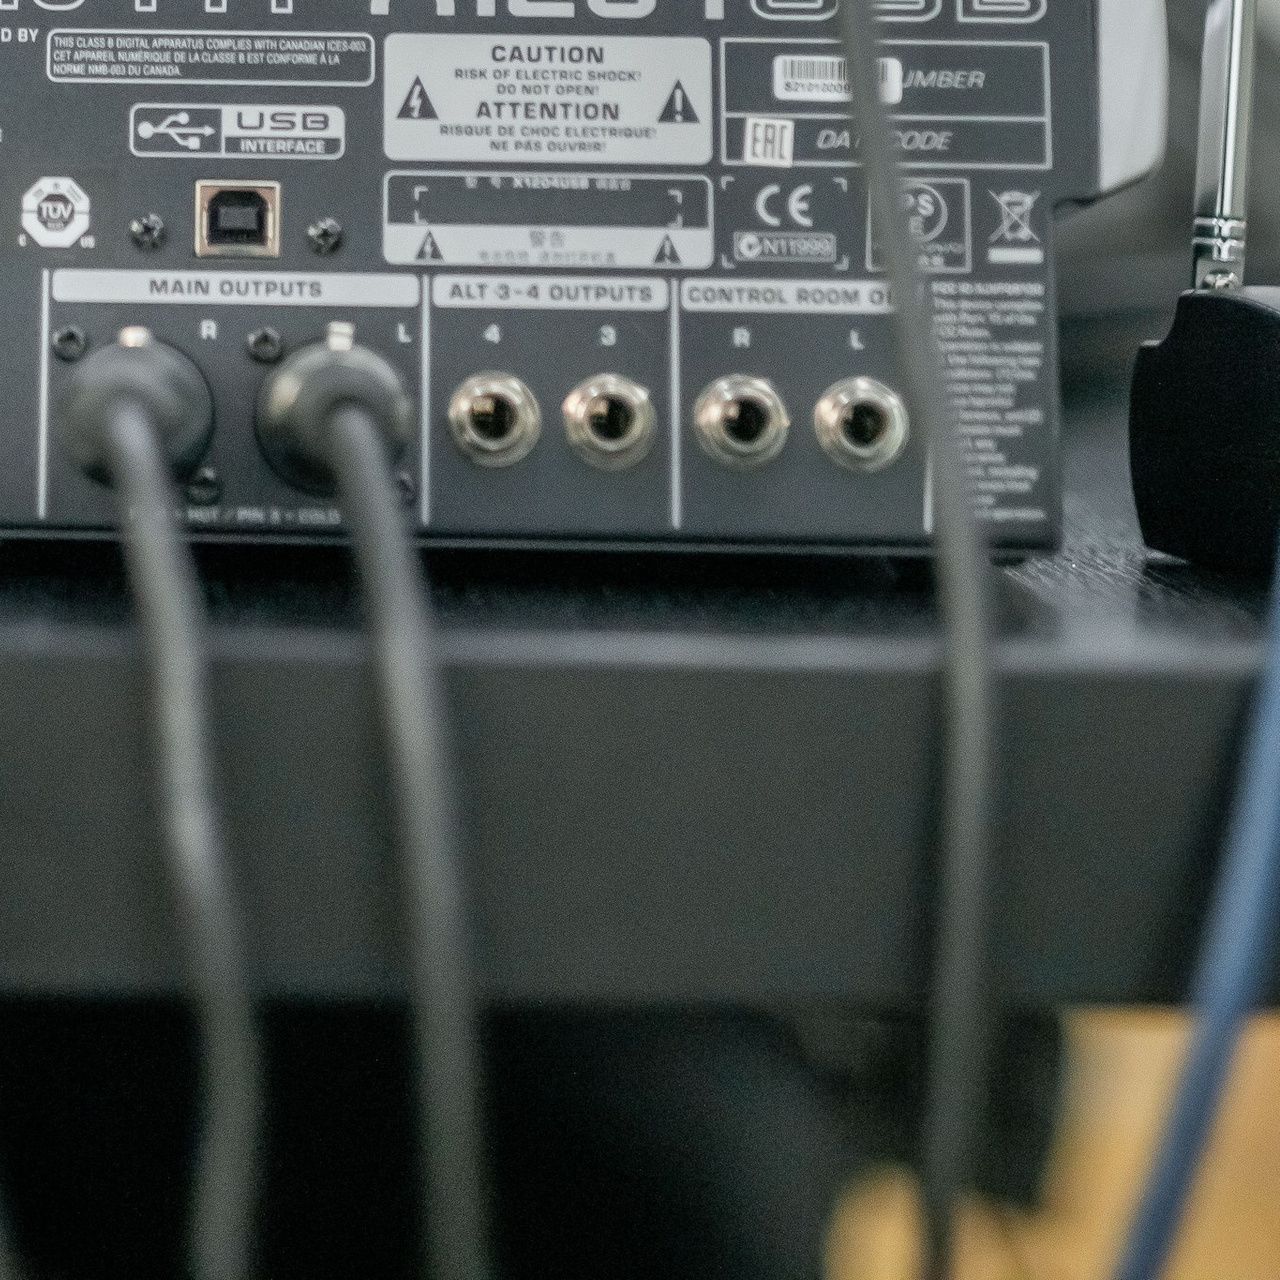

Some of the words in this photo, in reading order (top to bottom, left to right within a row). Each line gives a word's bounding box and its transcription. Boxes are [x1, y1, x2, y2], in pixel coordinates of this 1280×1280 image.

[18, 28, 39, 43] BY
[53, 36, 74, 48] THIS
[76, 36, 107, 49] CLASS
[116, 37, 151, 49] DIGITAL
[152, 37, 205, 50] APPARATUS
[206, 38, 252, 51] COMPLIES
[254, 38, 277, 51] WITH
[279, 39, 325, 52] CANADIAN
[53, 50, 71, 62] CET
[73, 50, 116, 62] APPAREIL
[173, 51, 186, 63] DE
[188, 52, 200, 63] LA
[201, 52, 236, 64] CLASSE
[246, 52, 265, 64] EST
[490, 45, 605, 64] CAUTION
[455, 68, 488, 81] RISK
[493, 69, 511, 81] OF
[515, 69, 583, 82] ELECTRIC
[902, 69, 987, 89] UMBER
[496, 84, 518, 96] DO
[521, 84, 550, 96] NOT
[236, 111, 330, 131] USB
[476, 101, 621, 121] ATTENTION
[439, 125, 492, 138] RISQUE
[497, 126, 516, 138] DE
[520, 126, 559, 138] CHOC
[240, 139, 326, 154] INTERFACE
[490, 140, 510, 152] NE
[514, 141, 542, 152] PAS
[755, 184, 814, 227] CE
[148, 278, 211, 296] MAIN
[219, 279, 323, 298] OUTPUTS
[449, 282, 488, 300] ALT
[549, 284, 654, 303] OUTPUTS
[687, 285, 788, 305] CONTROL
[795, 287, 859, 306] ROOM
[199, 319, 219, 340] R
[396, 321, 413, 343] L
[483, 323, 501, 344] 4
[732, 326, 751, 347] R
[849, 329, 865, 351] L
